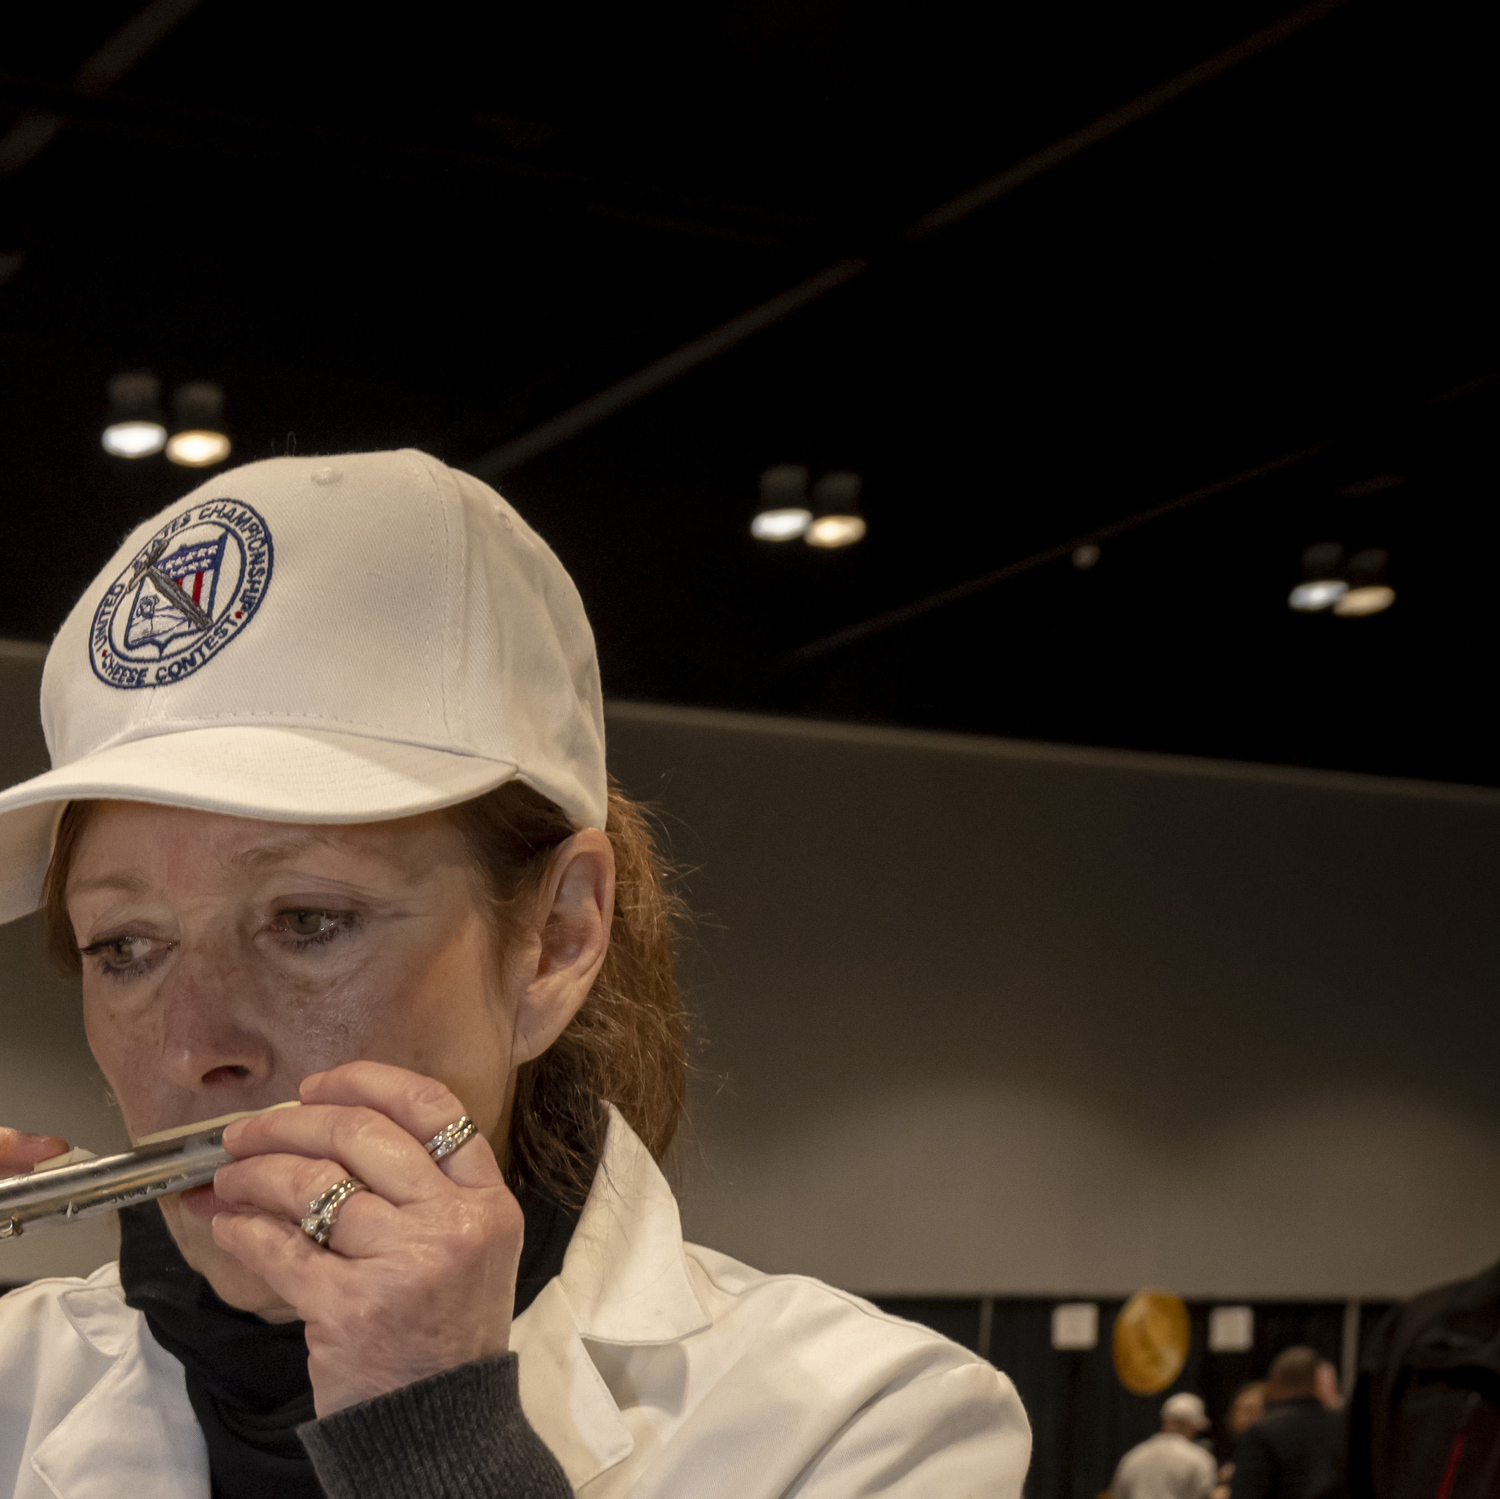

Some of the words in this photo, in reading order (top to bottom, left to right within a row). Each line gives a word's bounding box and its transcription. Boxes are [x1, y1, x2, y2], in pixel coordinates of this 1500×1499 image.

[94, 583, 124, 653] UNITED
[198, 504, 267, 613] CHAMPIONSHIP
[101, 652, 150, 686] CHEESE
[155, 613, 238, 682] CONTEST
